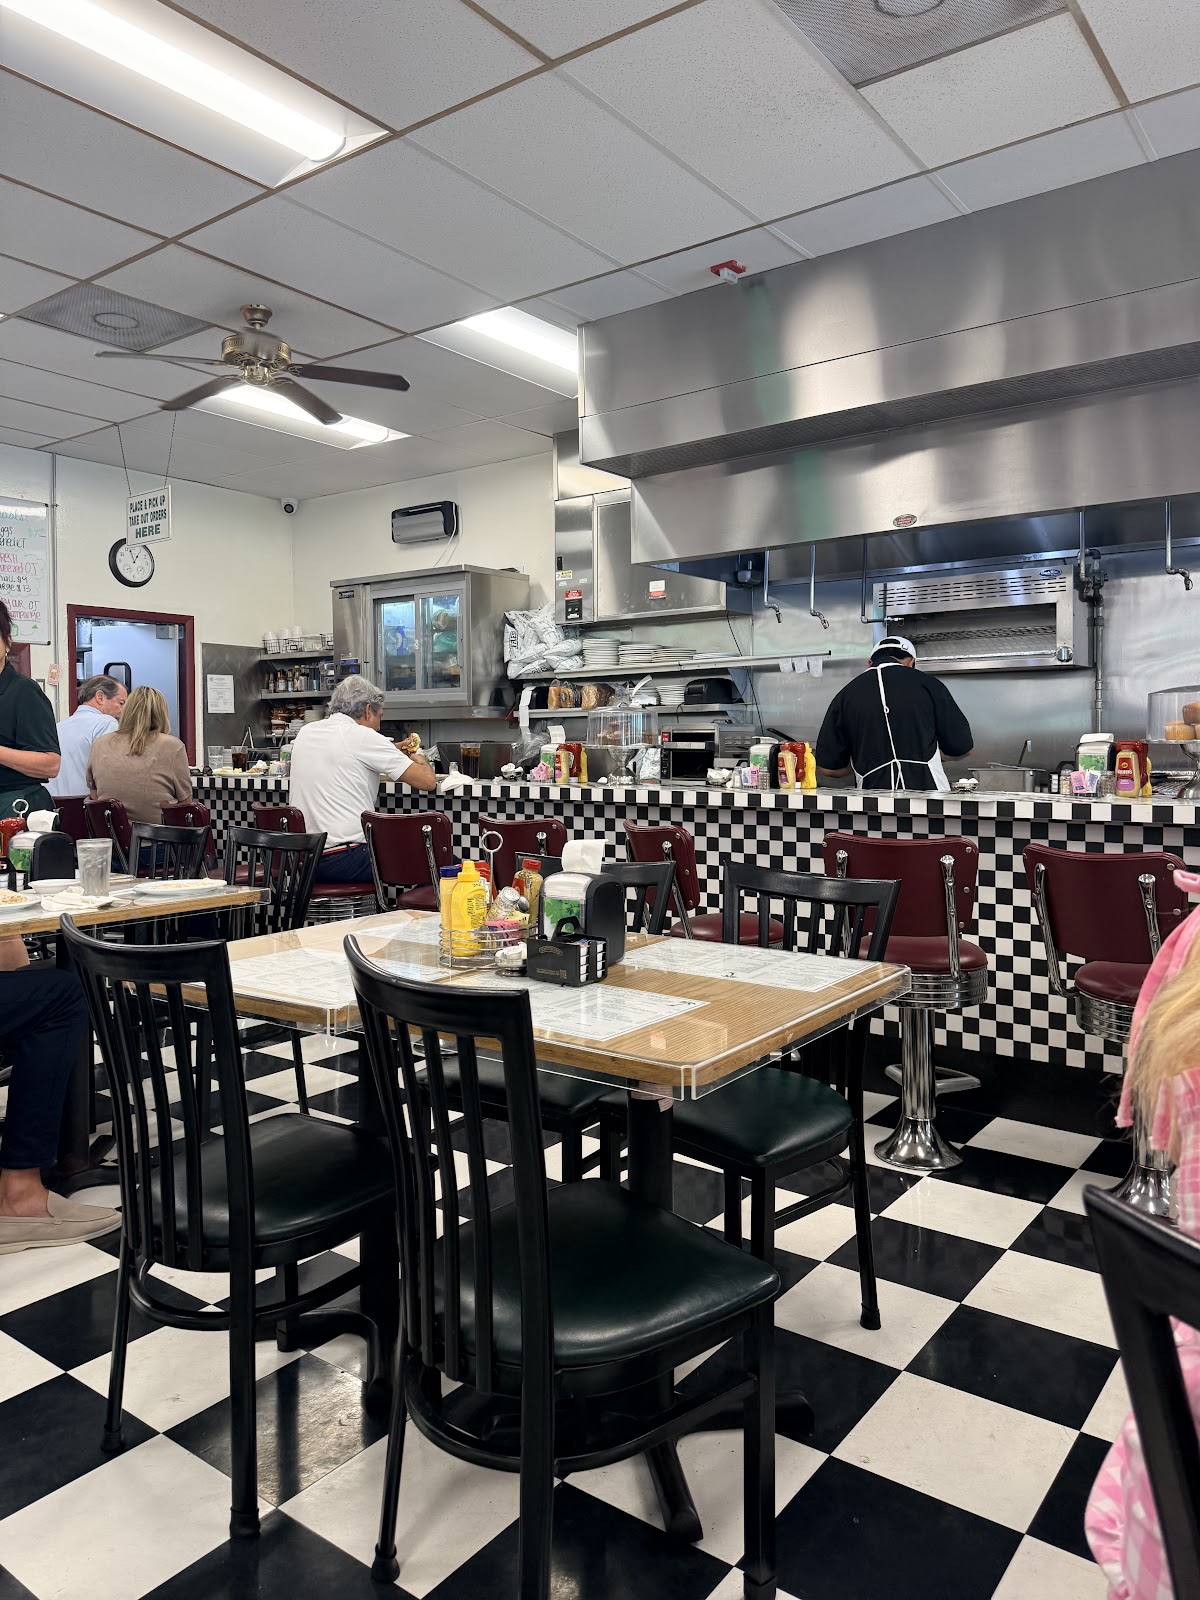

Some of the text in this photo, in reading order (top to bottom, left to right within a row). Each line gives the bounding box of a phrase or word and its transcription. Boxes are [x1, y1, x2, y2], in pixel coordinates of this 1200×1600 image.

[130, 494, 166, 513] PLACE & PICK UP
[129, 515, 139, 527] TAKE
[150, 509, 167, 523] ORDERS
[135, 524, 160, 538] HERE
